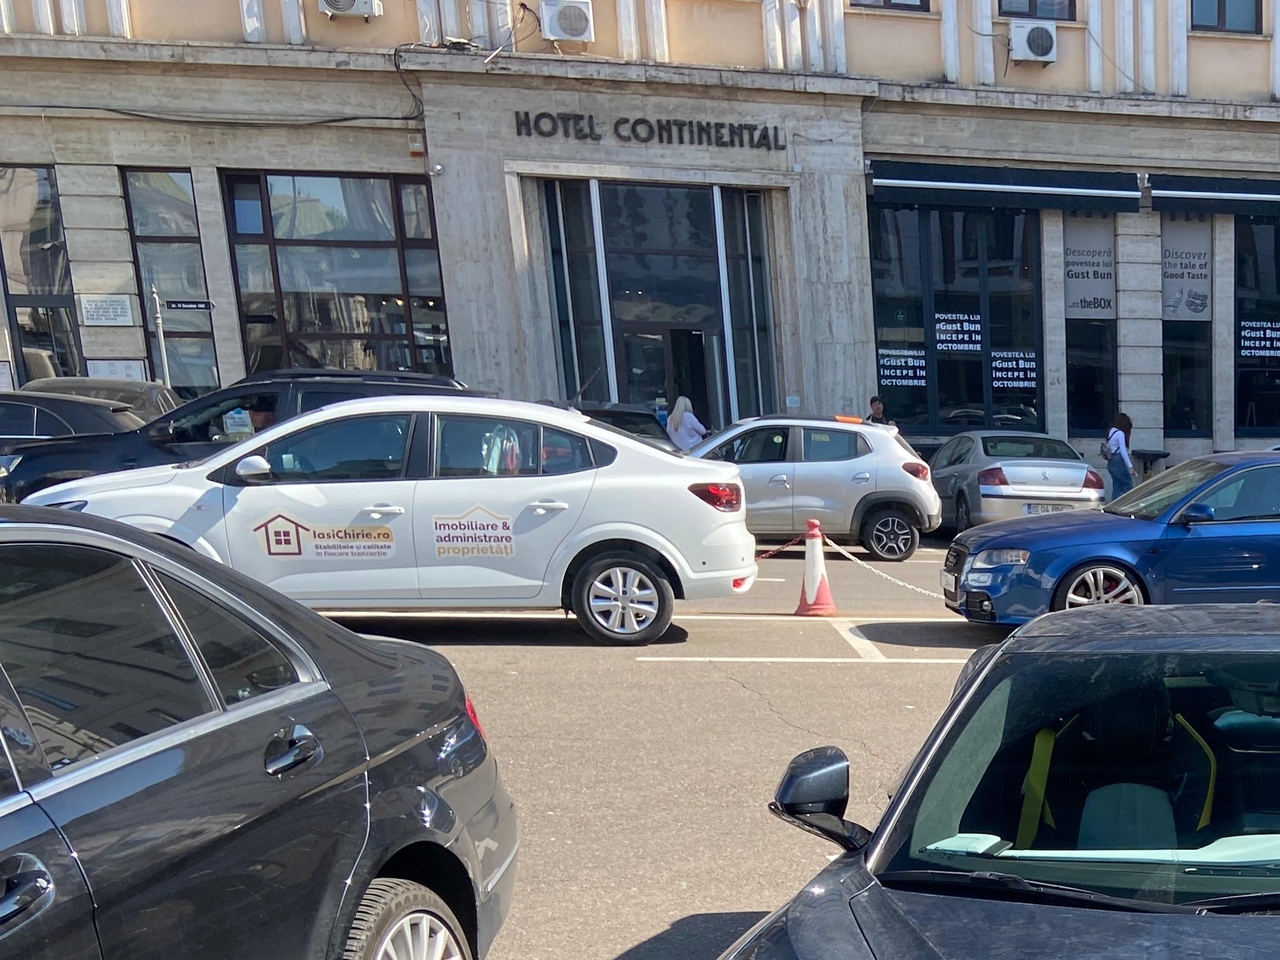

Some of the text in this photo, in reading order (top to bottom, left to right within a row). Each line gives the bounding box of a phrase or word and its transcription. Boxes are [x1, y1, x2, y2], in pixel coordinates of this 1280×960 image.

[514, 110, 786, 150] HOTEL CONTINENTAL
[1164, 249, 1208, 260] Discover
[1066, 260, 1112, 268] povestea lui
[1164, 261, 1178, 269] the
[1180, 261, 1196, 269] tale
[1066, 270, 1112, 280] Gust Bun
[1163, 271, 1208, 280] Good Taste
[1080, 297, 1112, 310] theBOX
[963, 322, 980, 331] Bun
[908, 358, 925, 367] Bun
[1019, 360, 1036, 368] Bun
[434, 521, 511, 531] Imobiliare &
[313, 530, 390, 540] IasiChirie.ro
[436, 533, 512, 543] administrare
[437, 544, 513, 557] proprietăți
